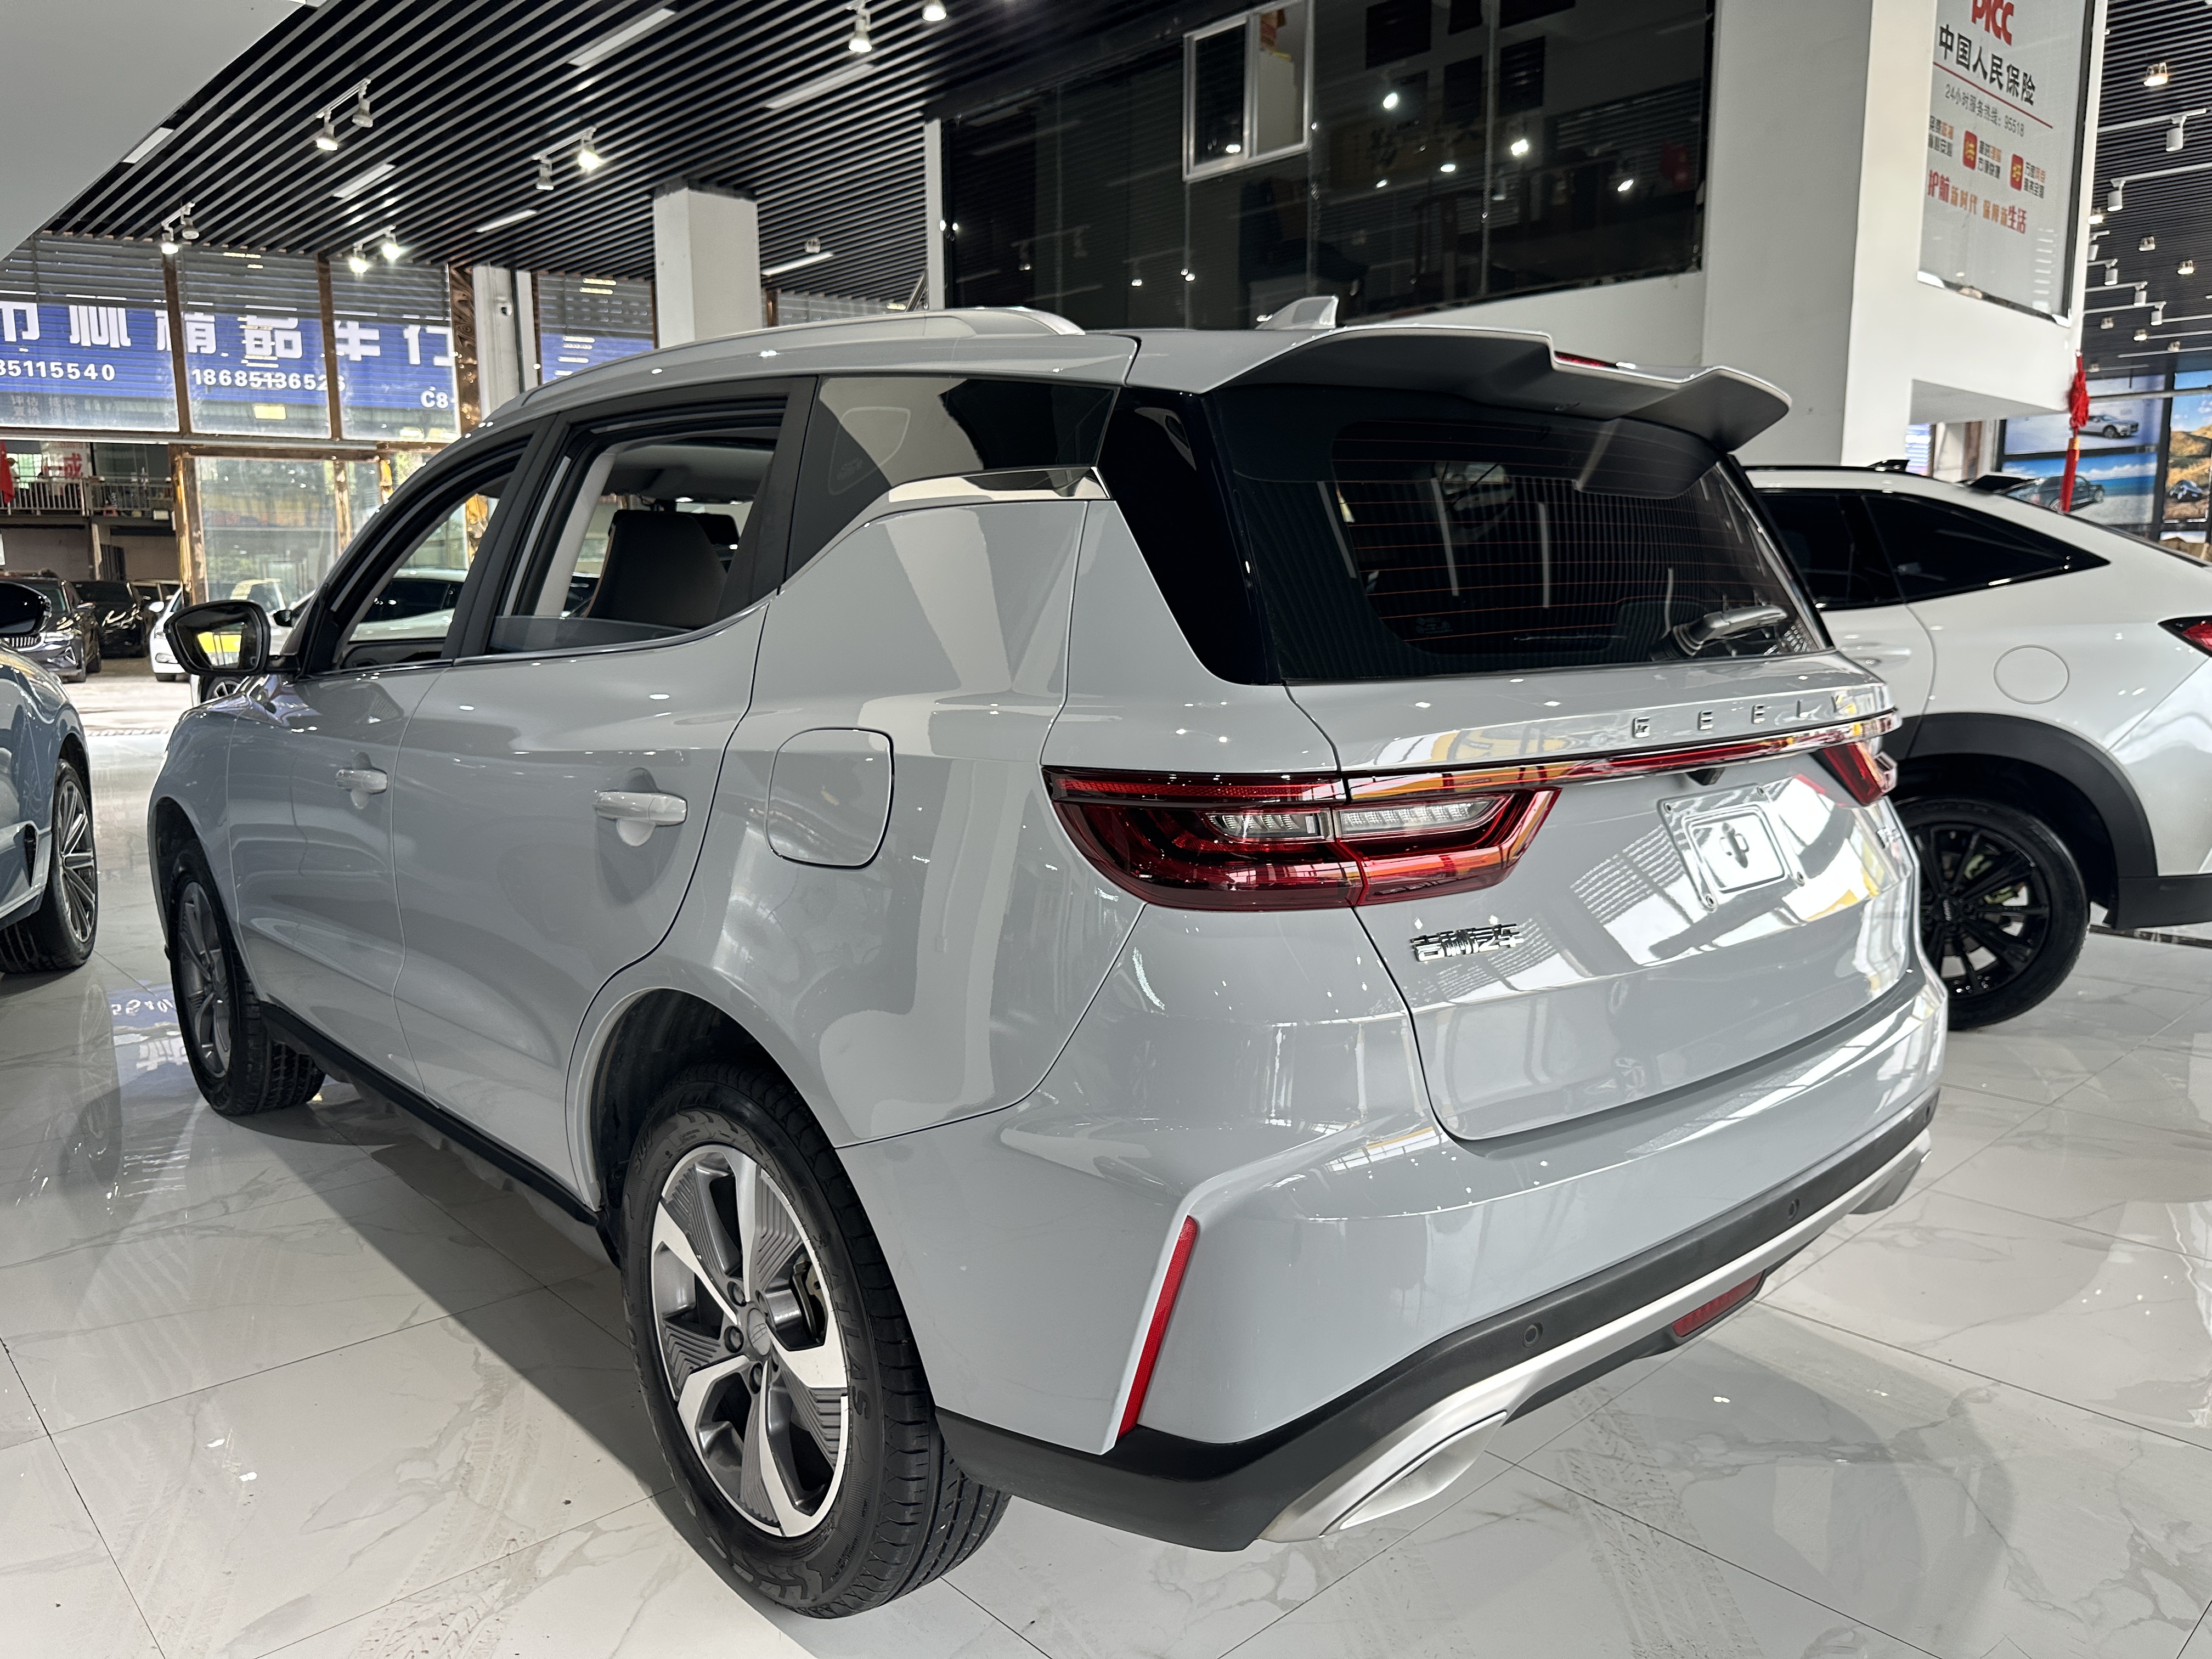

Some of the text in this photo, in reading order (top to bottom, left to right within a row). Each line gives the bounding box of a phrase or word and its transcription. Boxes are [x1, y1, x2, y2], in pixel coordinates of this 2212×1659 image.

[1939, 24, 2036, 106] 中国人民保险
[1633, 694, 1844, 738] GEELY
